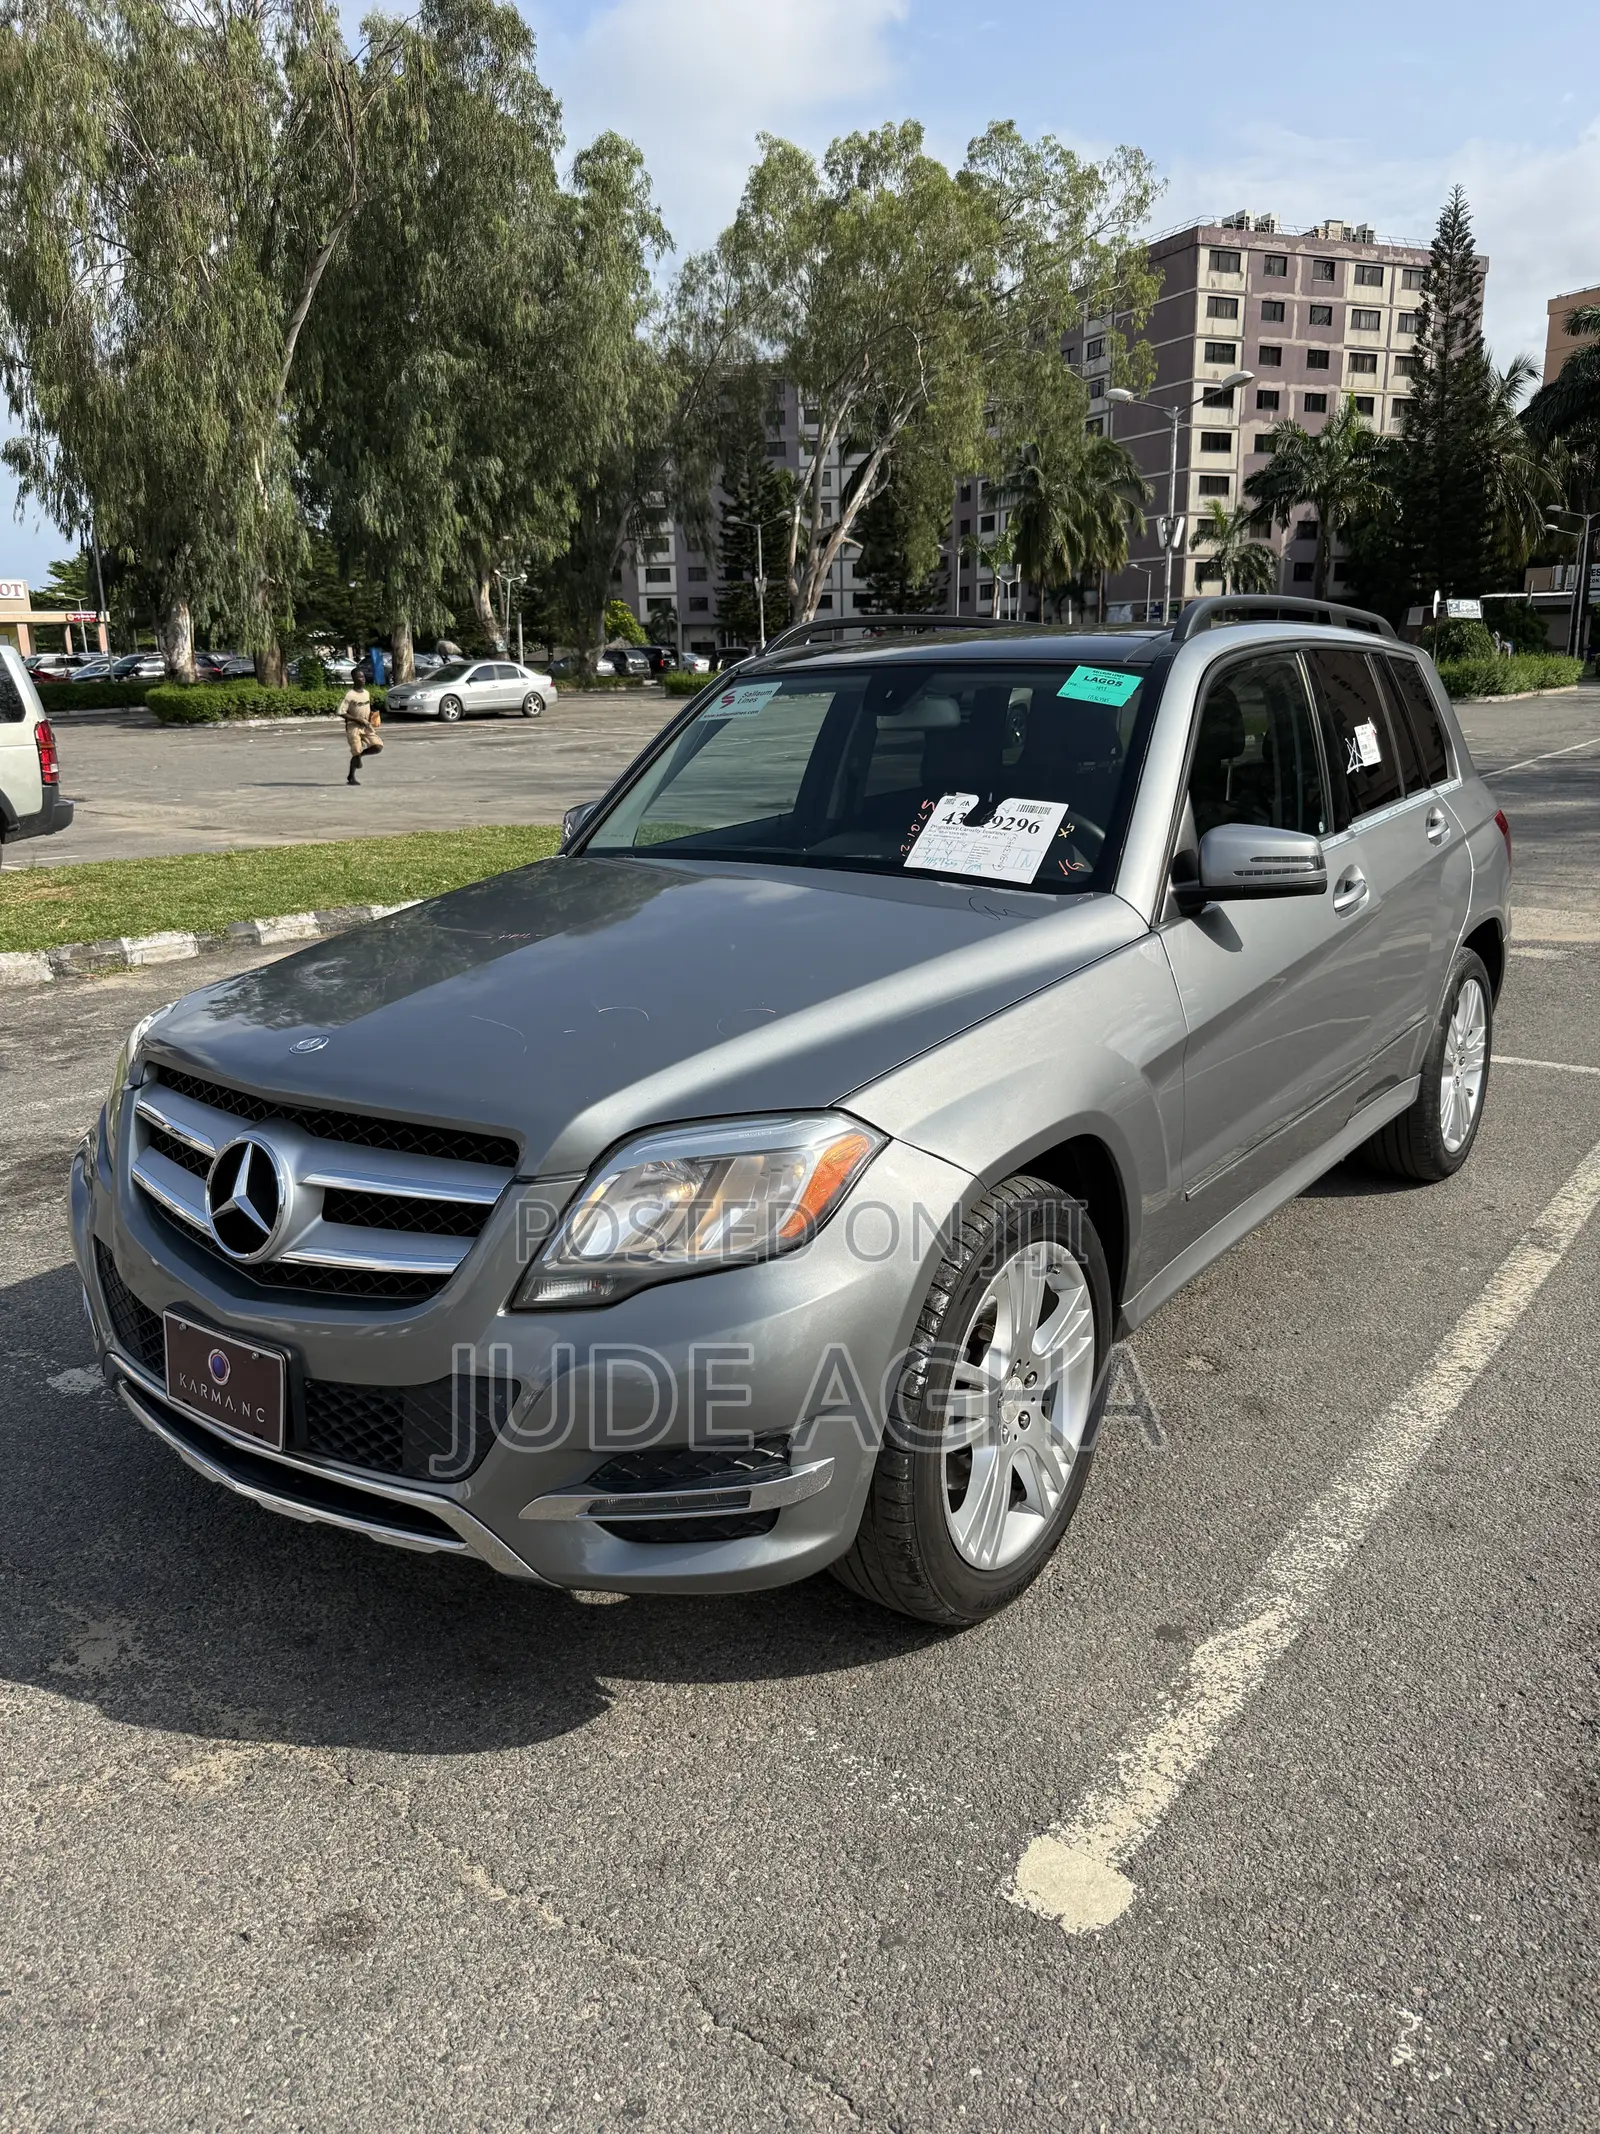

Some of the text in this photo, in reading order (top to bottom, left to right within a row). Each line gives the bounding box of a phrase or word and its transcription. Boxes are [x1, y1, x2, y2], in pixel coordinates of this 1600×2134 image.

[1083, 675, 1124, 687] LAGOS
[737, 697, 759, 705] Lines
[941, 811, 1044, 835] 439296
